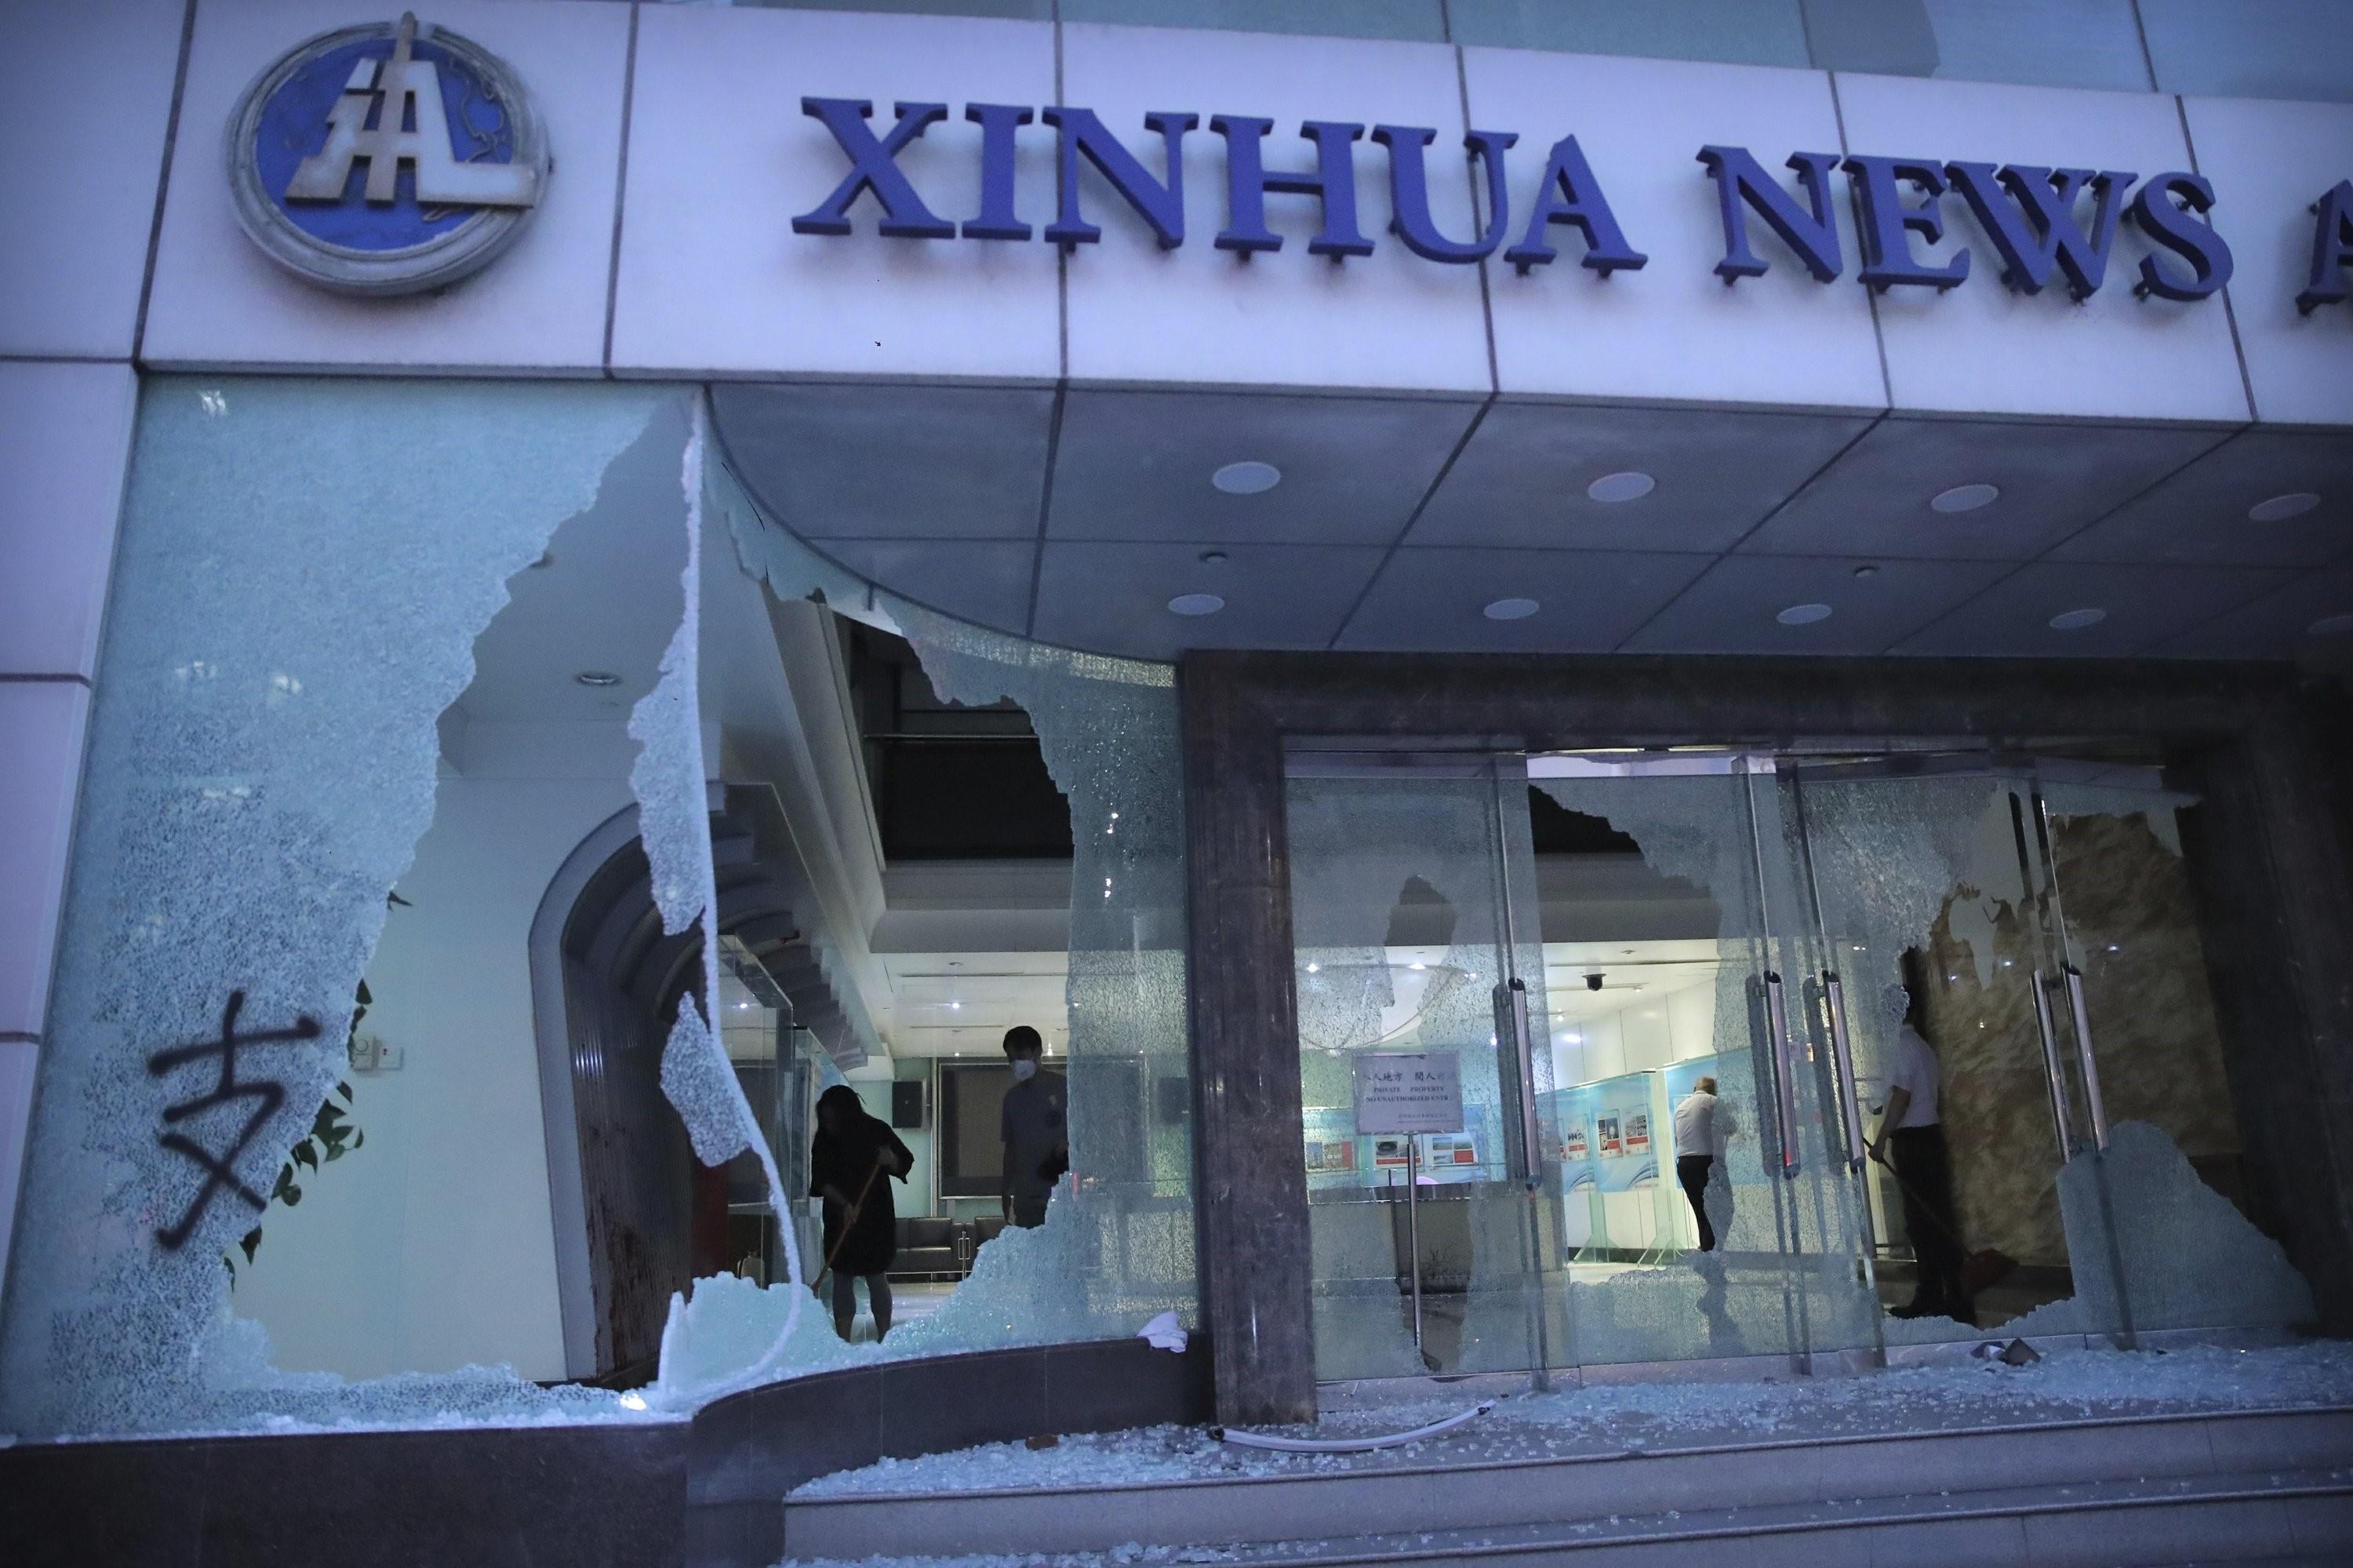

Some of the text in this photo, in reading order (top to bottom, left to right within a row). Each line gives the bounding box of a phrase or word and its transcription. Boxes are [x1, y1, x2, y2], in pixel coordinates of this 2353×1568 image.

[792, 96, 1648, 272] XINHUA
[1696, 144, 2234, 304] NEWS
[1366, 1071, 1403, 1082] 人地方
